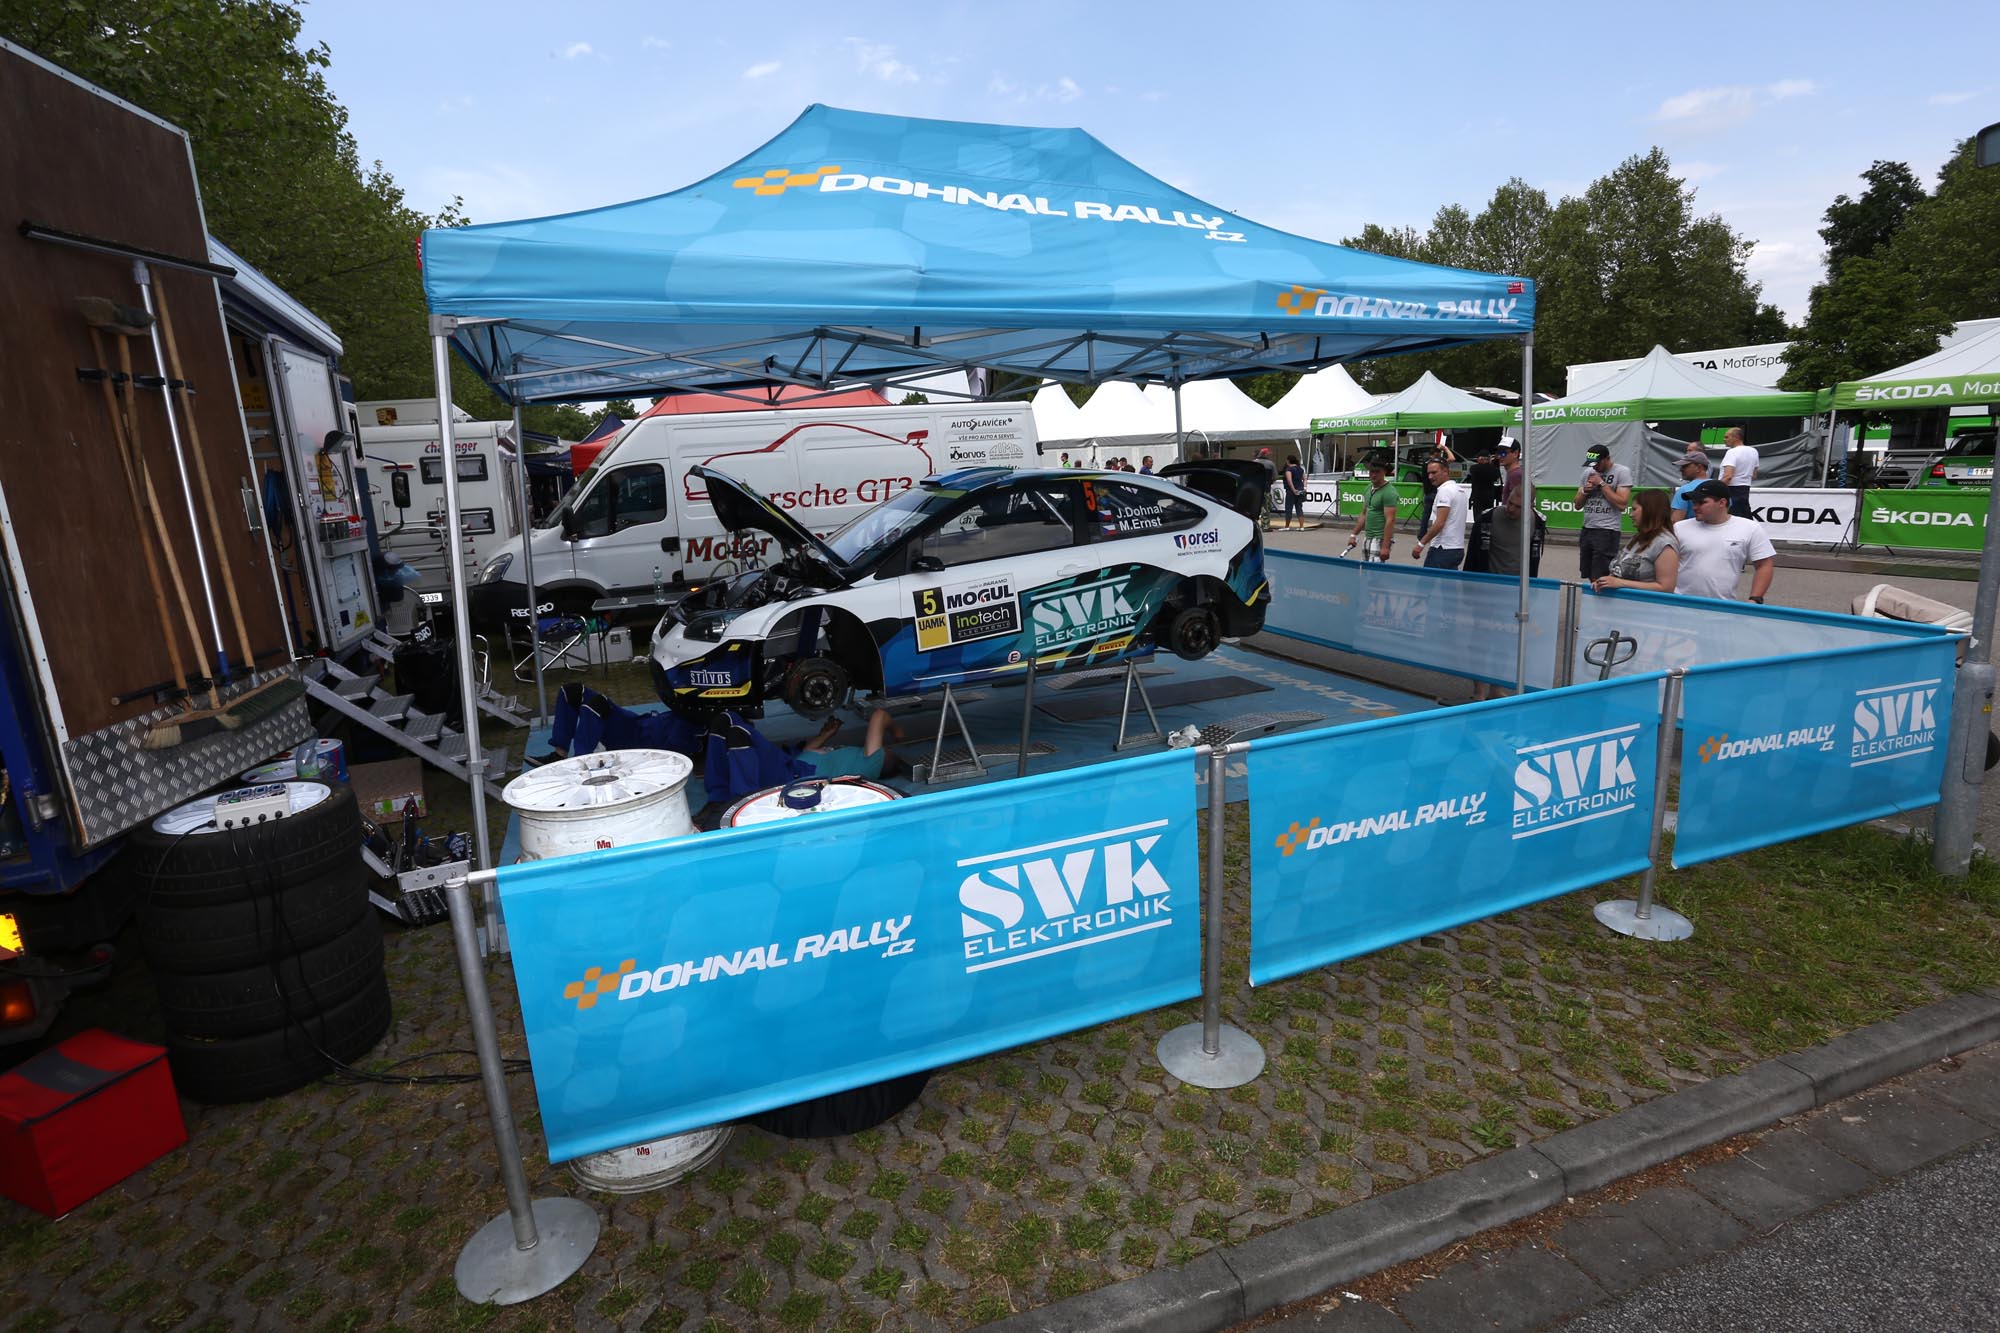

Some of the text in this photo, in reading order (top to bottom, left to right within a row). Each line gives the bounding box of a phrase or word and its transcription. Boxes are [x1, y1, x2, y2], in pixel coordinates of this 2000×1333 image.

[819, 173, 1225, 231] DOHNAL RALLY
[1315, 296, 1517, 319] DOHNAL RALLY
[1722, 355, 1783, 368] Motorspo
[1855, 383, 1954, 401] ŠKODA
[1317, 417, 1388, 430] ŠKODA Motorsport
[1514, 406, 1627, 422] ŠODA Motorsport
[424, 441, 478, 455] changer
[769, 482, 848, 510] rsche
[1082, 480, 1097, 512] 5
[1304, 491, 1333, 503] ODA
[1342, 491, 1364, 503] ŠKO
[1116, 504, 1164, 519] J.Dohnal
[1119, 516, 1163, 532] M.Ernst
[1750, 506, 1842, 526] KODA
[1871, 507, 1974, 527] ŠKODA
[1187, 528, 1219, 546] oresi
[685, 536, 774, 564] Motor
[922, 590, 938, 615] 5
[946, 584, 1015, 610] MOGUL
[1032, 582, 1135, 636] SVK
[956, 606, 1010, 629] inotech
[1035, 614, 1136, 647] ELEKTRONIK
[1010, 652, 1019, 661] E
[1852, 688, 1937, 743] SVK
[1717, 723, 1836, 761] DOHNAL RALLY
[1851, 729, 1936, 758] ELEKTRONIK
[1513, 735, 1636, 812] SVK
[1512, 784, 1636, 829] ELEKTRONIK
[1306, 791, 1486, 851] DOHNAL RALLY
[958, 834, 1171, 938] SVK
[964, 895, 1172, 959] ELEKTRONIK
[618, 914, 912, 1001] DOHNAL RALLY
[635, 1145, 651, 1157] Mg
